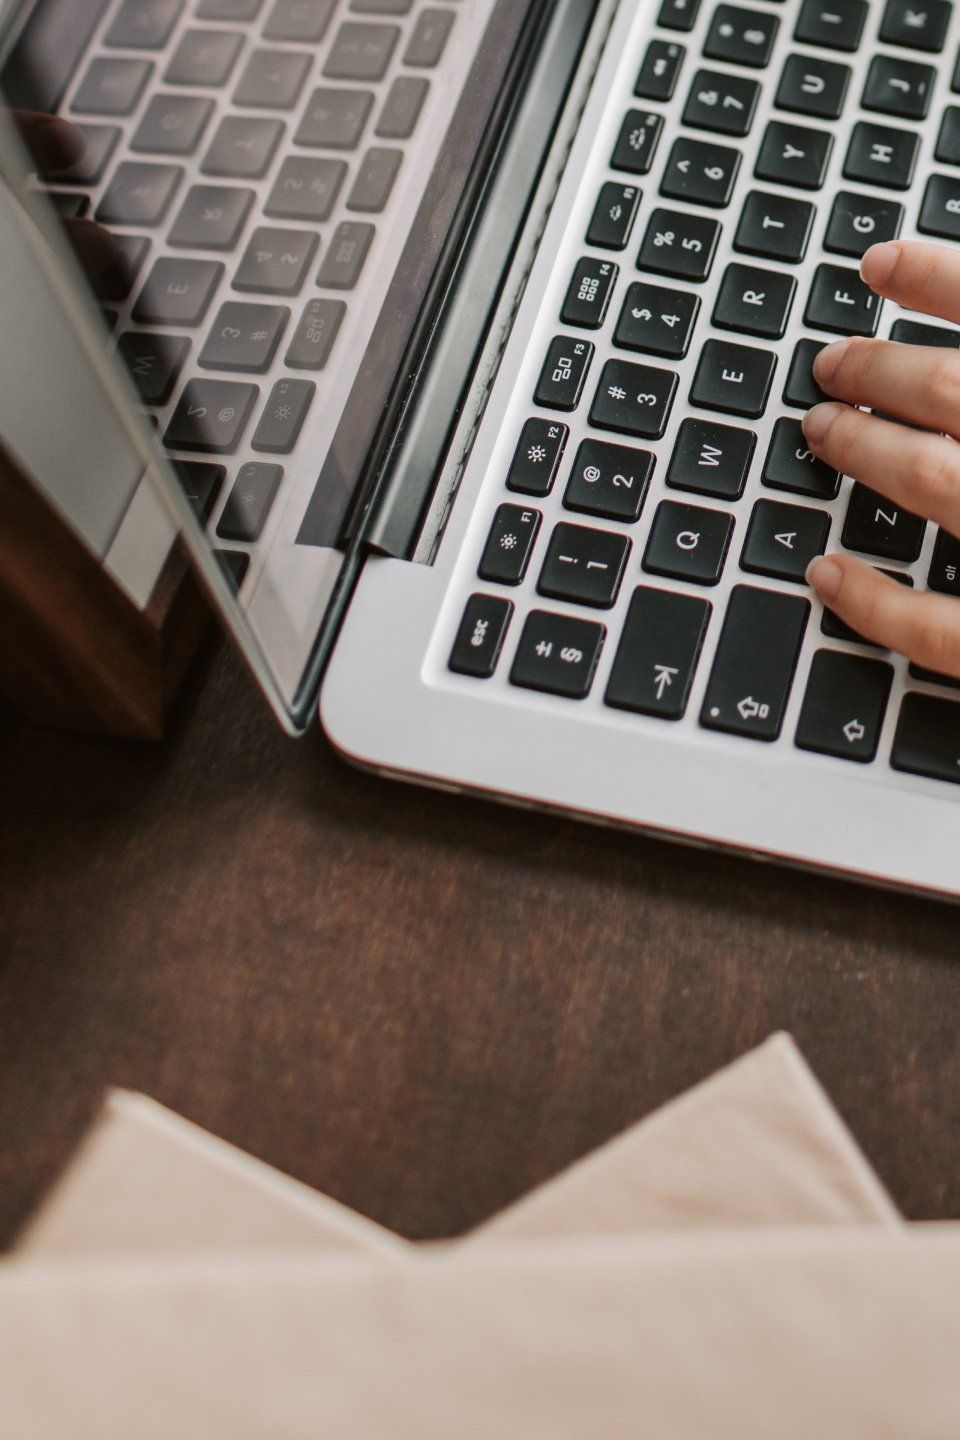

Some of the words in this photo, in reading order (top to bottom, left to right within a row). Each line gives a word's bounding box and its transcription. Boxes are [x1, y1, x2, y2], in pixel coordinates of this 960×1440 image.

[801, 74, 825, 94] U
[889, 78, 910, 92] J
[723, 96, 744, 110] 7
[782, 144, 805, 159] Y
[870, 144, 893, 163] H
[703, 167, 724, 180] 6
[763, 216, 785, 229] T
[852, 216, 875, 233] G
[654, 232, 675, 247] %
[682, 238, 702, 252] 5
[599, 264, 611, 275] F4
[742, 290, 765, 305] R
[834, 290, 855, 305] F
[631, 308, 652, 321] $
[661, 314, 681, 328] 4
[573, 344, 585, 354] F3
[722, 370, 744, 383] E
[607, 386, 627, 400] #
[637, 393, 657, 406] 3
[548, 426, 559, 438] F2
[698, 444, 722, 466] W
[583, 466, 601, 482] @
[612, 474, 634, 488] 2
[521, 512, 532, 522] F1
[874, 508, 897, 526] Z
[676, 531, 700, 550] Q
[774, 532, 797, 549] A
[945, 566, 957, 581] alt
[471, 620, 488, 647] esc
